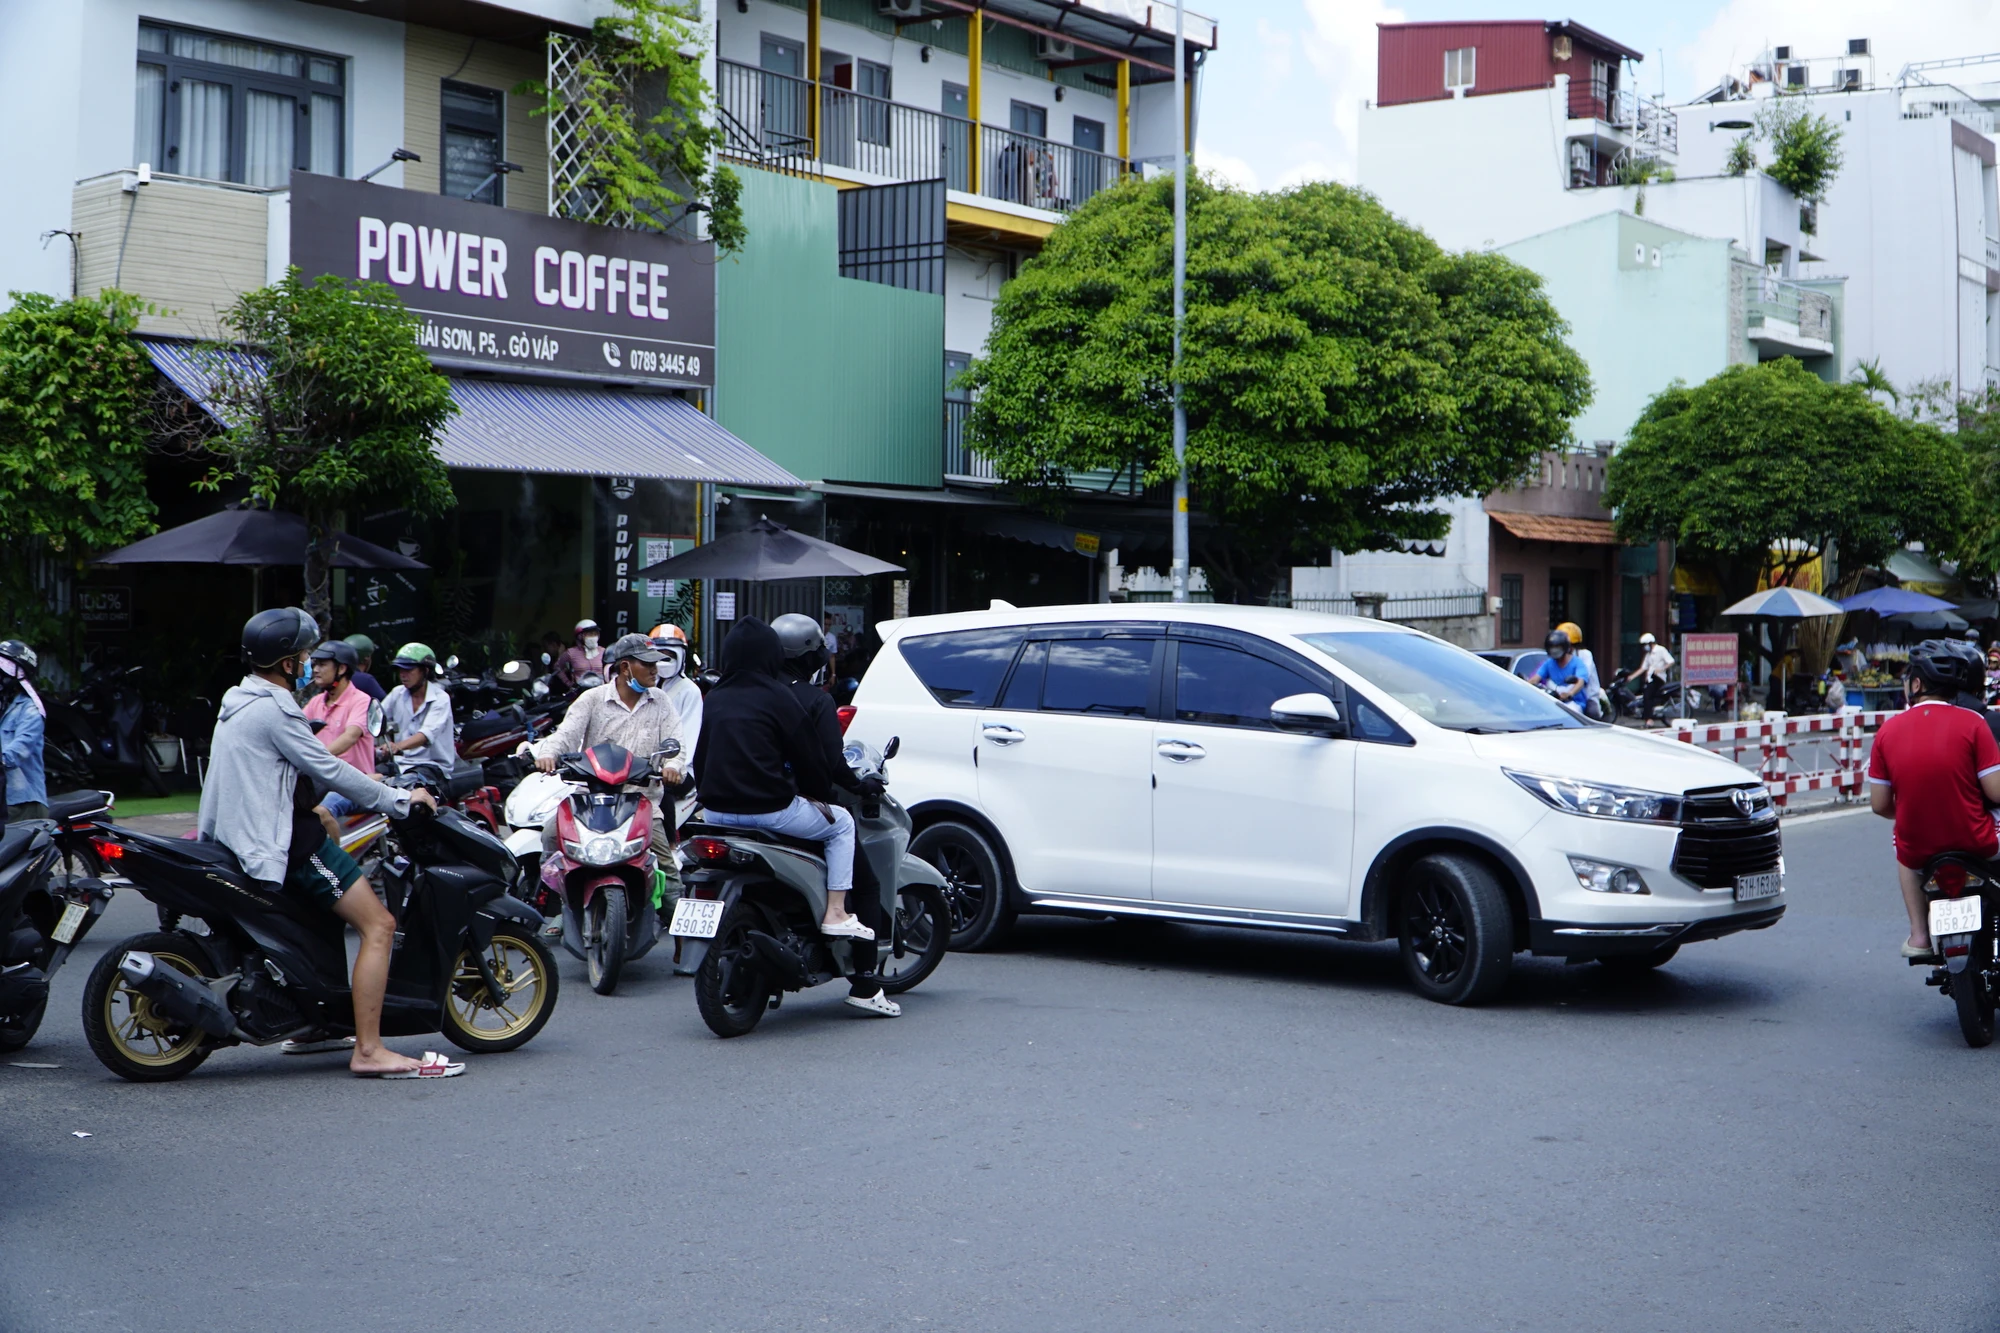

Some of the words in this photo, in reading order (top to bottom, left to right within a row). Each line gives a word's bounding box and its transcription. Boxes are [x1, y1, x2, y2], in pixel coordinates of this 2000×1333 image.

[357, 216, 508, 299] POWER
[534, 245, 670, 321] COFFEE
[441, 326, 476, 356] SƠN,
[478, 331, 499, 358] P5,
[509, 331, 530, 358] GÒ
[630, 349, 657, 372] 0789
[659, 352, 685, 375] 3445
[686, 355, 701, 376] 49
[682, 902, 716, 918] 71-C3
[674, 917, 715, 935] 590.36
[1936, 914, 1977, 933] 058.27
